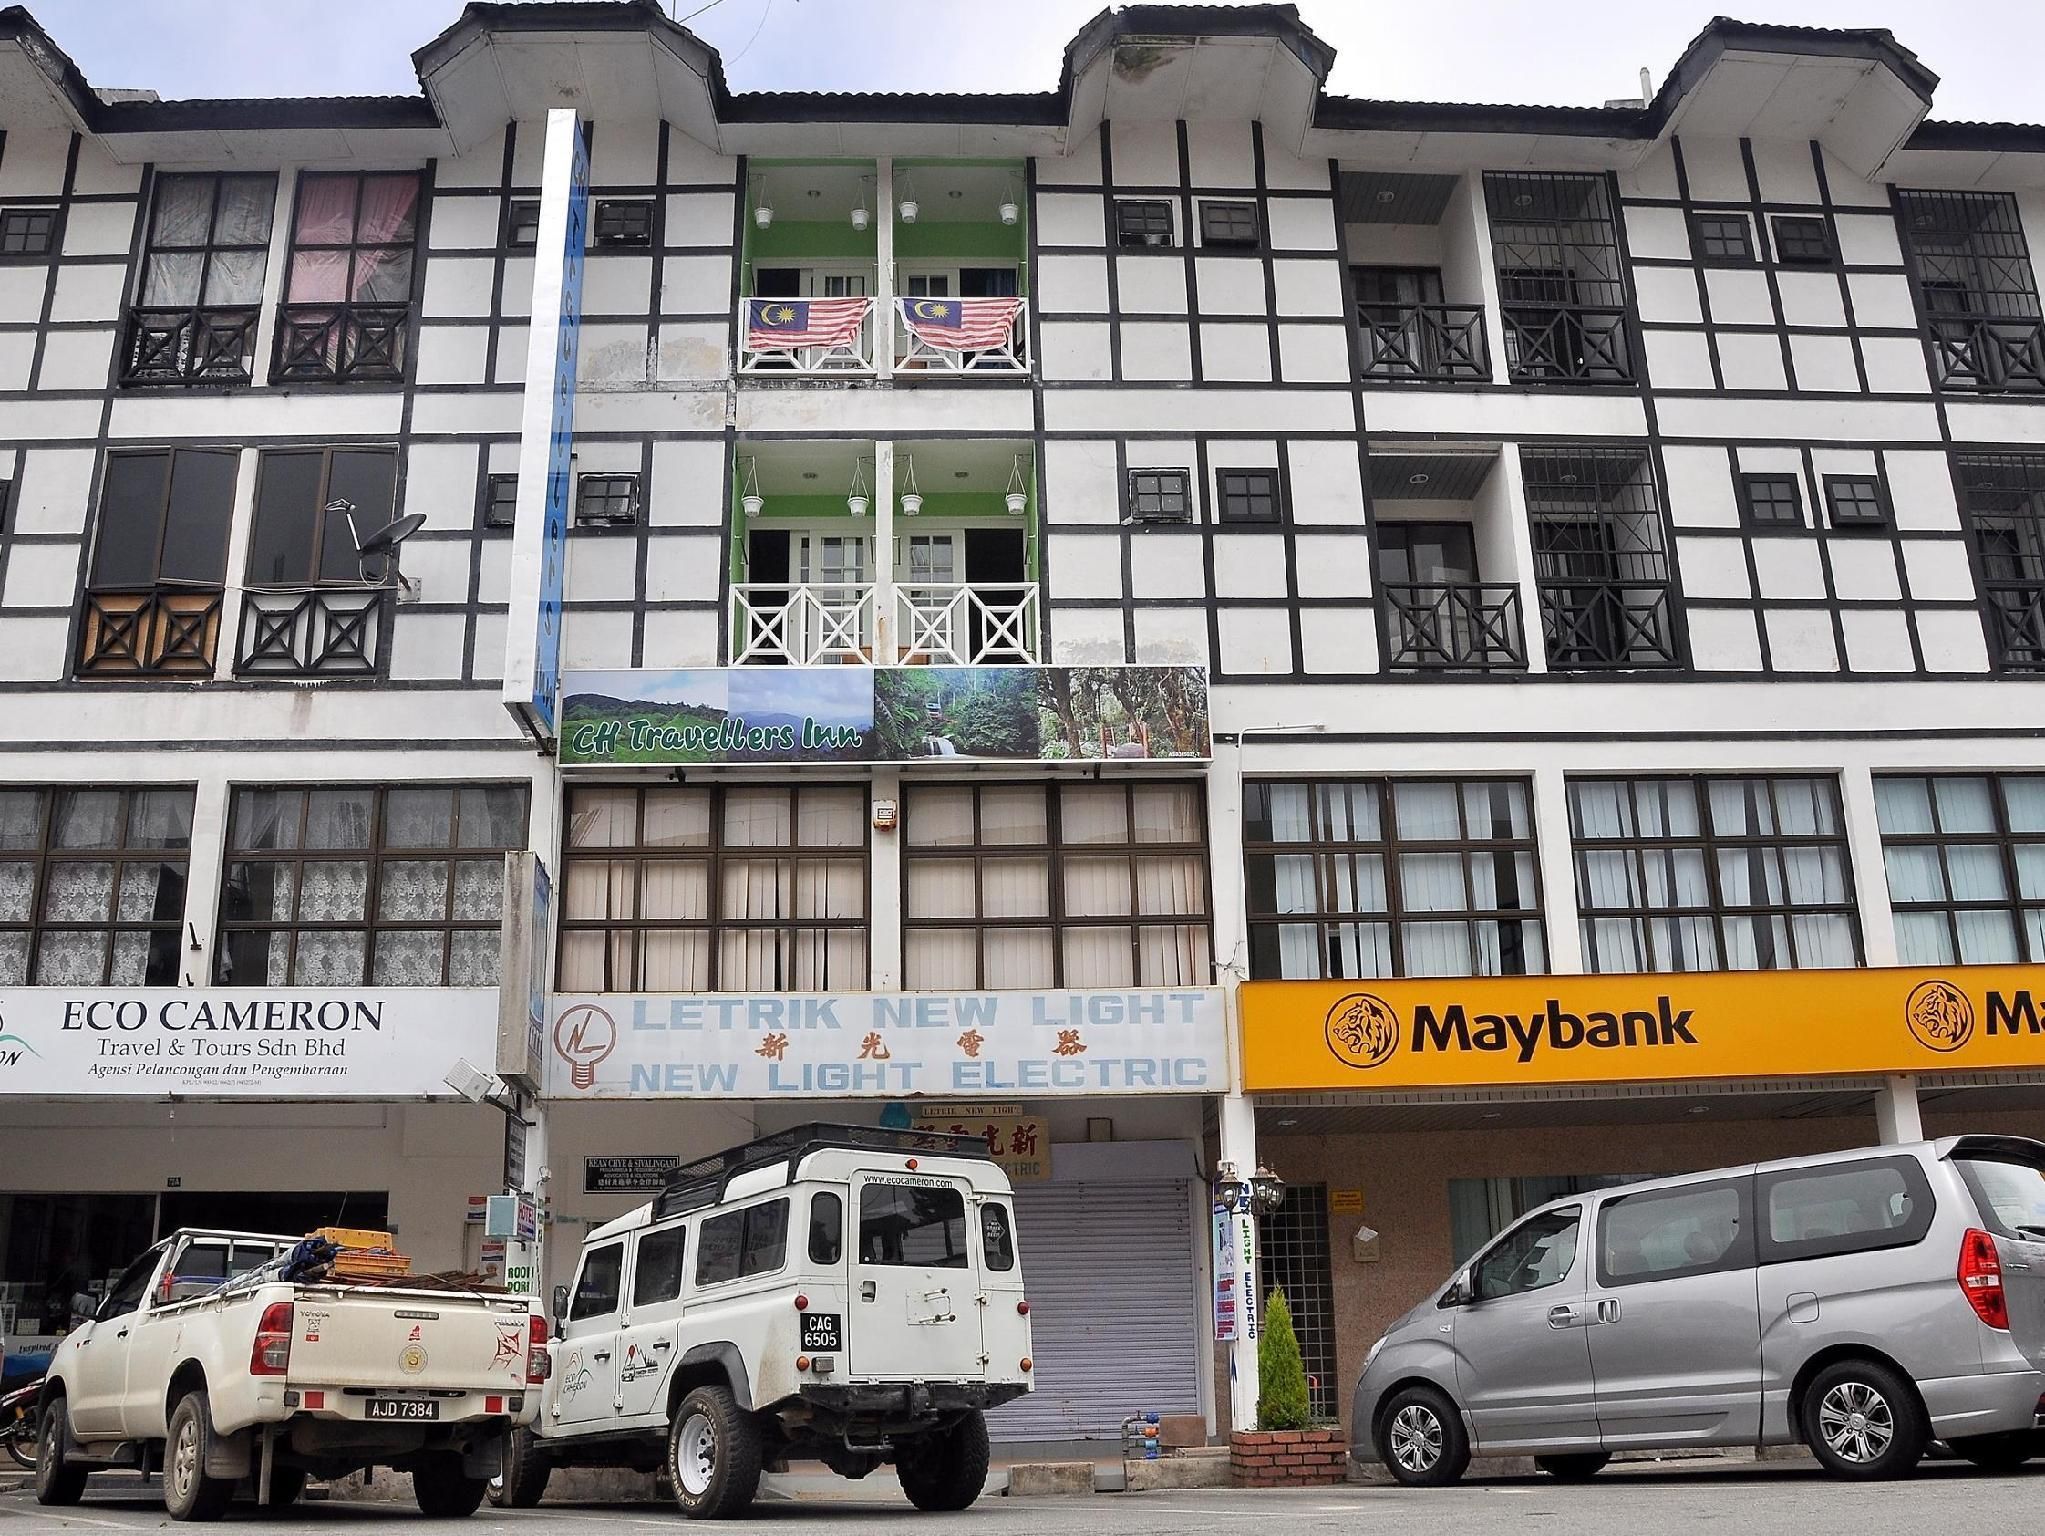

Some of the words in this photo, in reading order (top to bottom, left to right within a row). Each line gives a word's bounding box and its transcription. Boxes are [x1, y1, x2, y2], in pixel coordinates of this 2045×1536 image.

[572, 721, 621, 754] CH
[628, 717, 795, 752] Travellers
[800, 716, 863, 750] Inn
[61, 1001, 148, 1031] ECO
[159, 1001, 386, 1031] CAMERON
[632, 999, 841, 1031] LETRIK
[872, 997, 1000, 1029] NEW
[1032, 994, 1205, 1026] LIGHT
[1410, 996, 1699, 1063] Maybank
[97, 1039, 161, 1056] Travel
[168, 1039, 185, 1056] &
[192, 1039, 252, 1056] Tours
[257, 1038, 298, 1056] Sdn
[304, 1038, 346, 1056] Bhd
[88, 1063, 132, 1078] Agensi
[136, 1063, 219, 1078] Pelancongan
[222, 1063, 247, 1075] dan
[251, 1063, 348, 1079] Pengembaraan
[630, 1063, 738, 1092] NEW
[768, 1061, 923, 1091] LIGHT
[953, 1057, 1207, 1089] ELECTRIC
[863, 1175, 953, 1189] www.ecocameron.com
[809, 1316, 832, 1331] CAG
[804, 1332, 837, 1346] 6505
[372, 1401, 397, 1415] AJD
[401, 1402, 433, 1417] 7384
